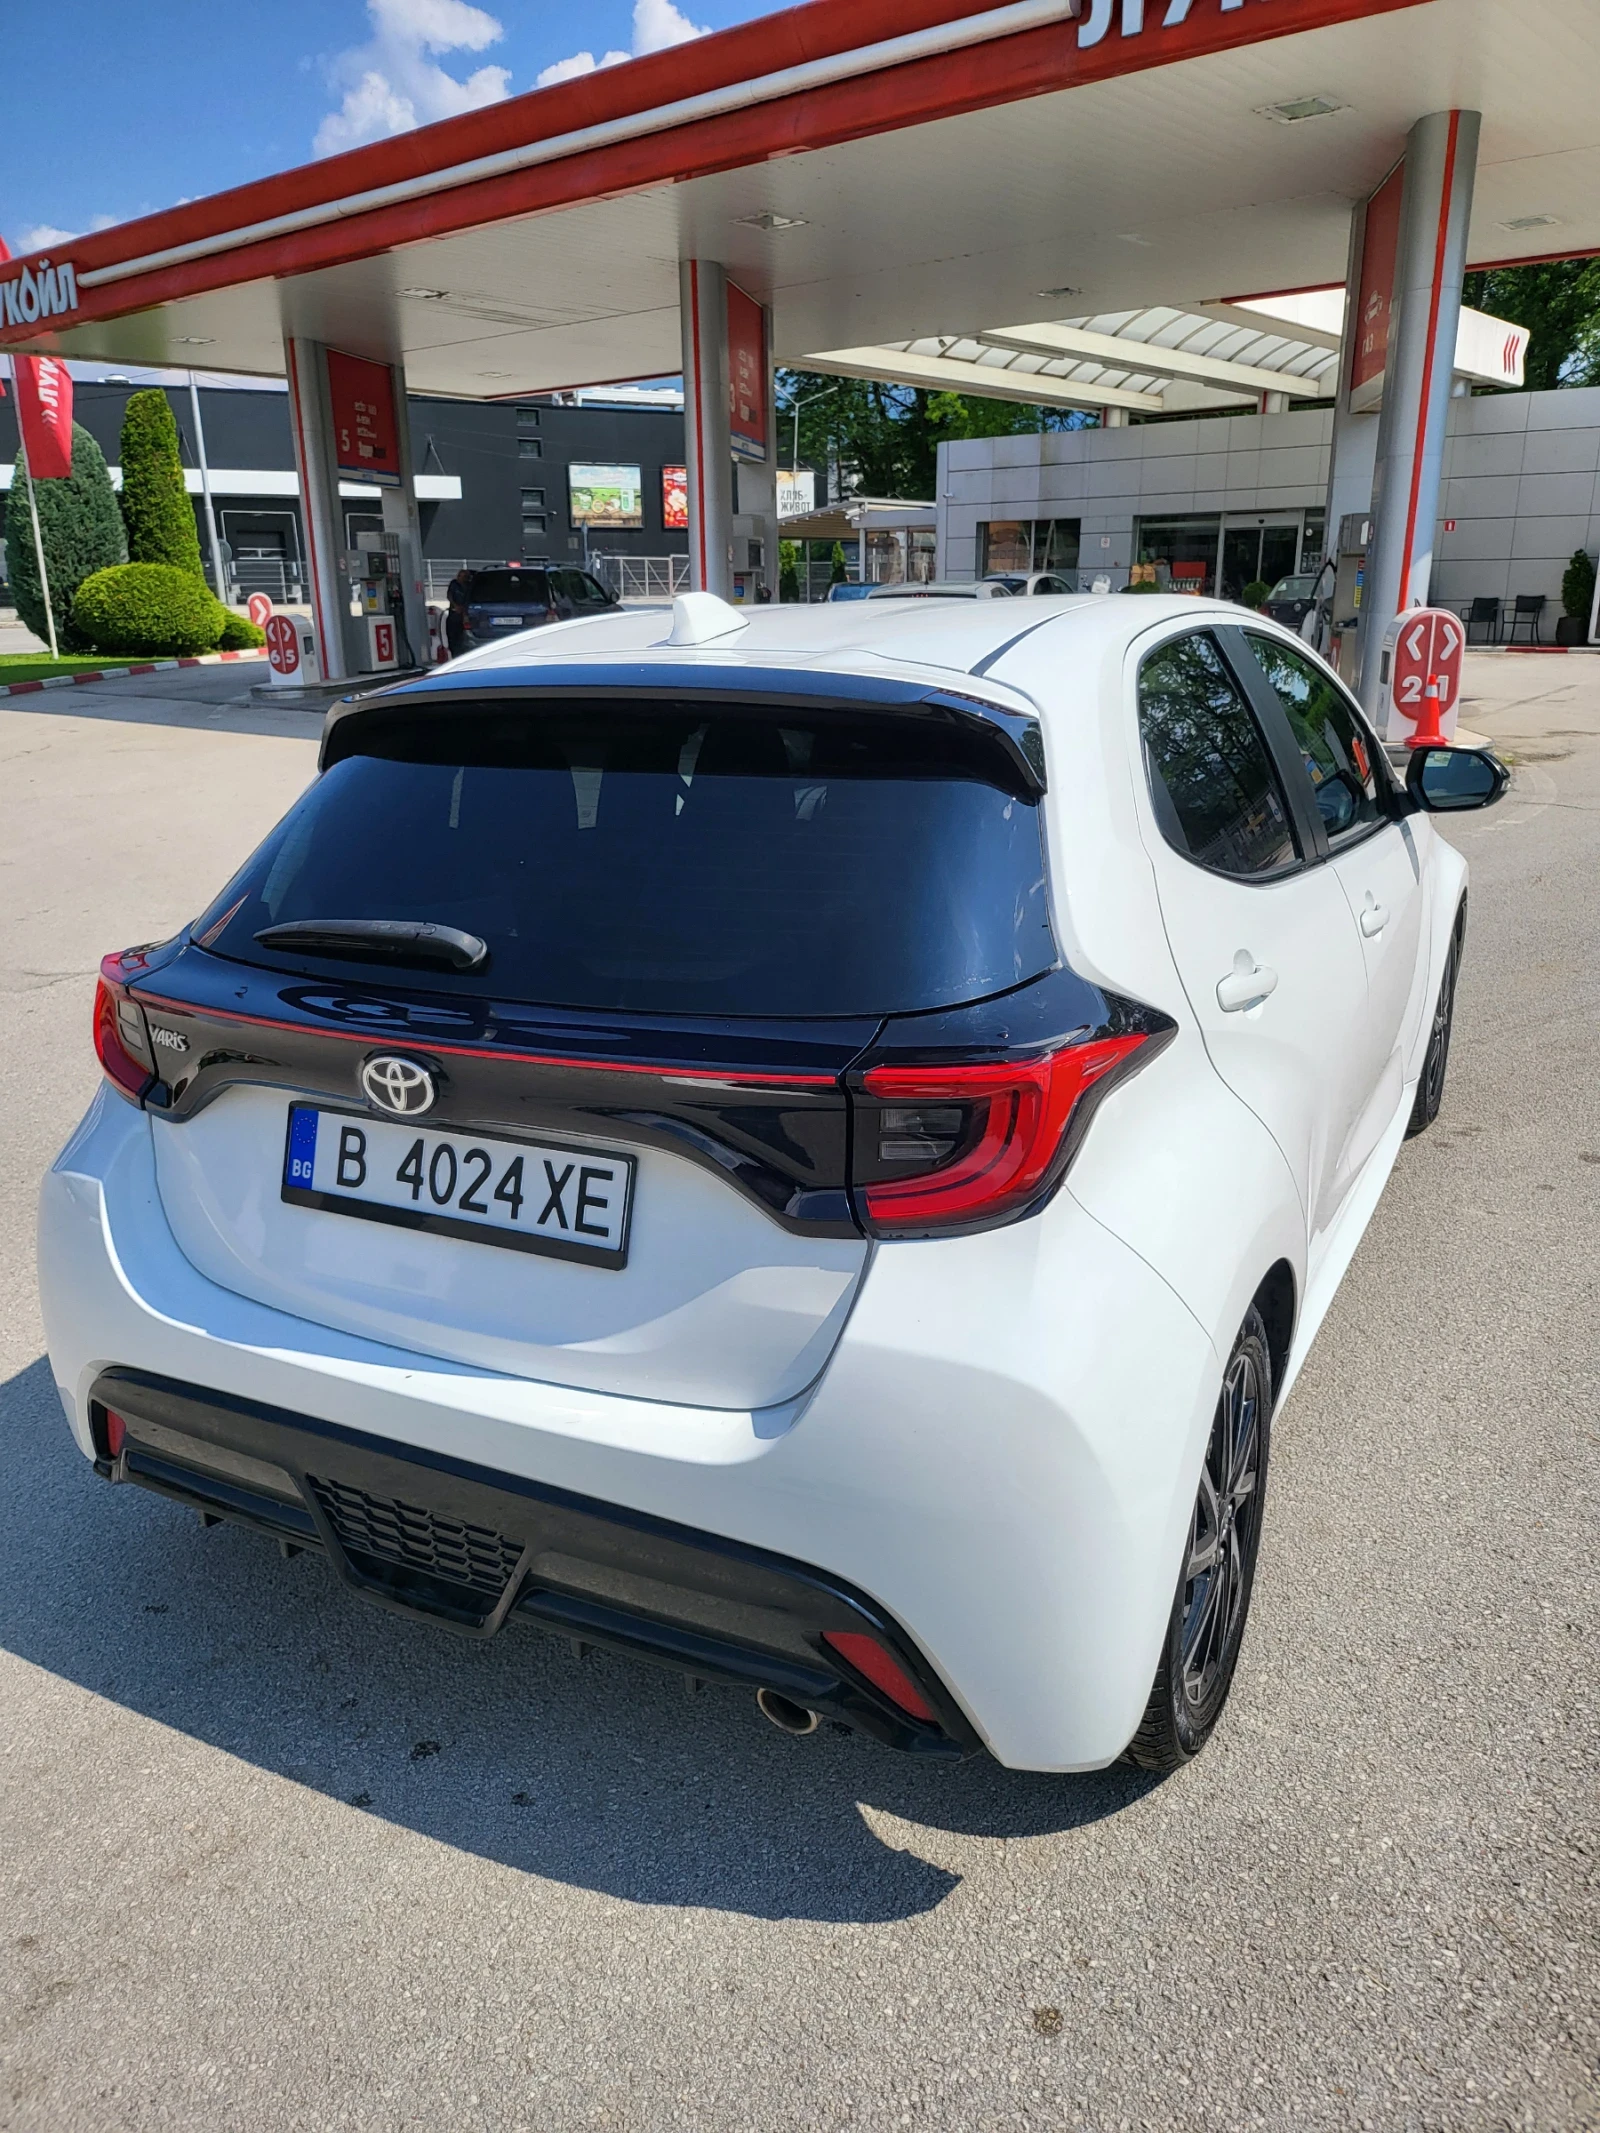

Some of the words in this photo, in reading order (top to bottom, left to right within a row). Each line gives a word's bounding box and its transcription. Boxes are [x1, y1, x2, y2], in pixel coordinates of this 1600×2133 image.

[0, 258, 78, 329] КОЙЛ
[342, 429, 351, 452] 5
[781, 502, 811, 513] ЖИВОТ
[380, 629, 390, 657] 5
[270, 649, 281, 664] 6
[284, 649, 296, 664] 5
[1400, 675, 1423, 702] 2
[1437, 675, 1449, 701] 1
[292, 1159, 312, 1179] BG
[337, 1126, 366, 1188] B
[396, 1139, 525, 1219] 4024
[537, 1160, 613, 1237] XE
